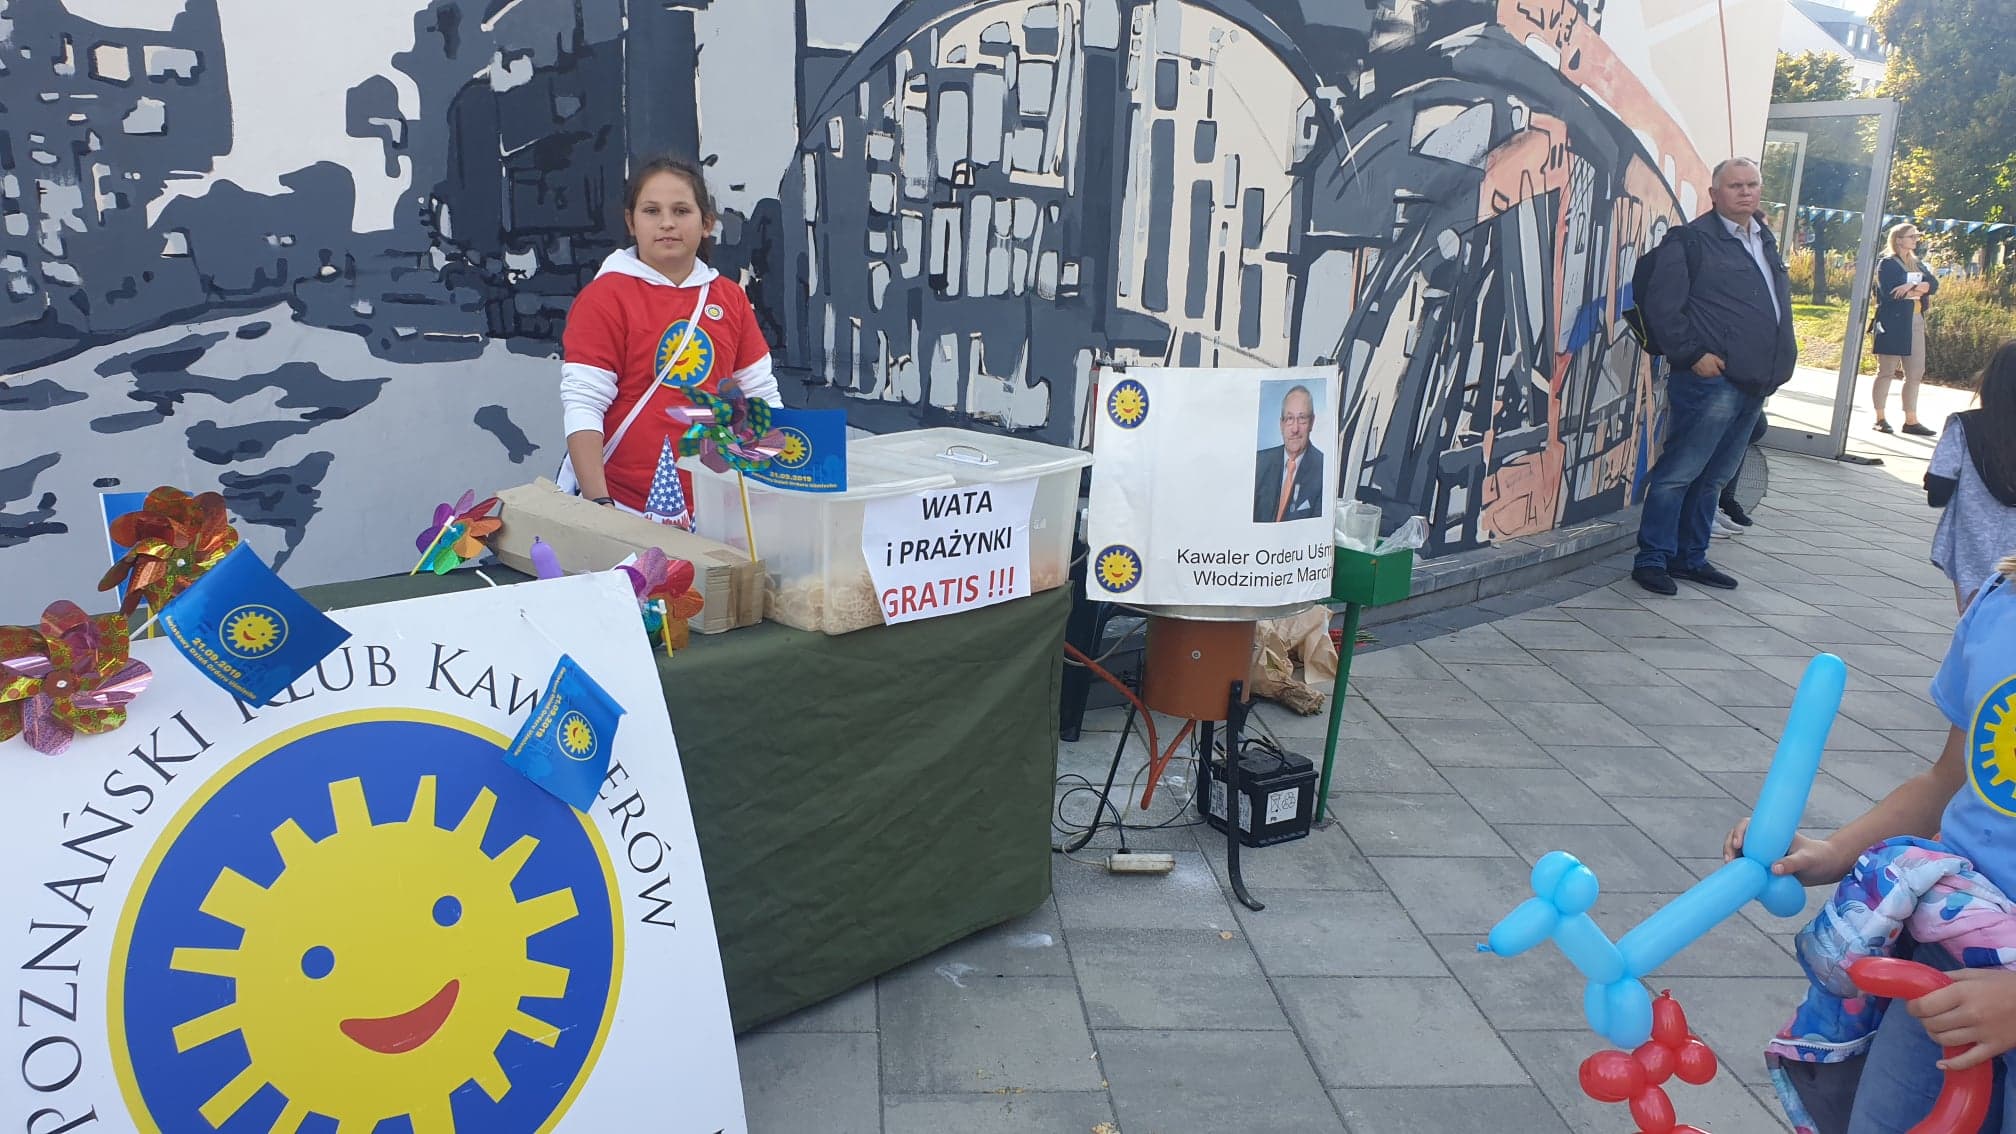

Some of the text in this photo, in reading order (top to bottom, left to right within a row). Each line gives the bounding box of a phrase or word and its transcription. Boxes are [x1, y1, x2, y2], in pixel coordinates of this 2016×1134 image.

[922, 490, 992, 520] WATA
[887, 526, 1012, 566] i PRAŻYNKI
[1177, 548, 1249, 564] Kawaler
[1255, 549, 1303, 565] Orderu
[882, 566, 1015, 618] GRATIS !!!
[1193, 570, 1293, 587] Włodzimierz
[425, 641, 677, 931] KAWERÓW
